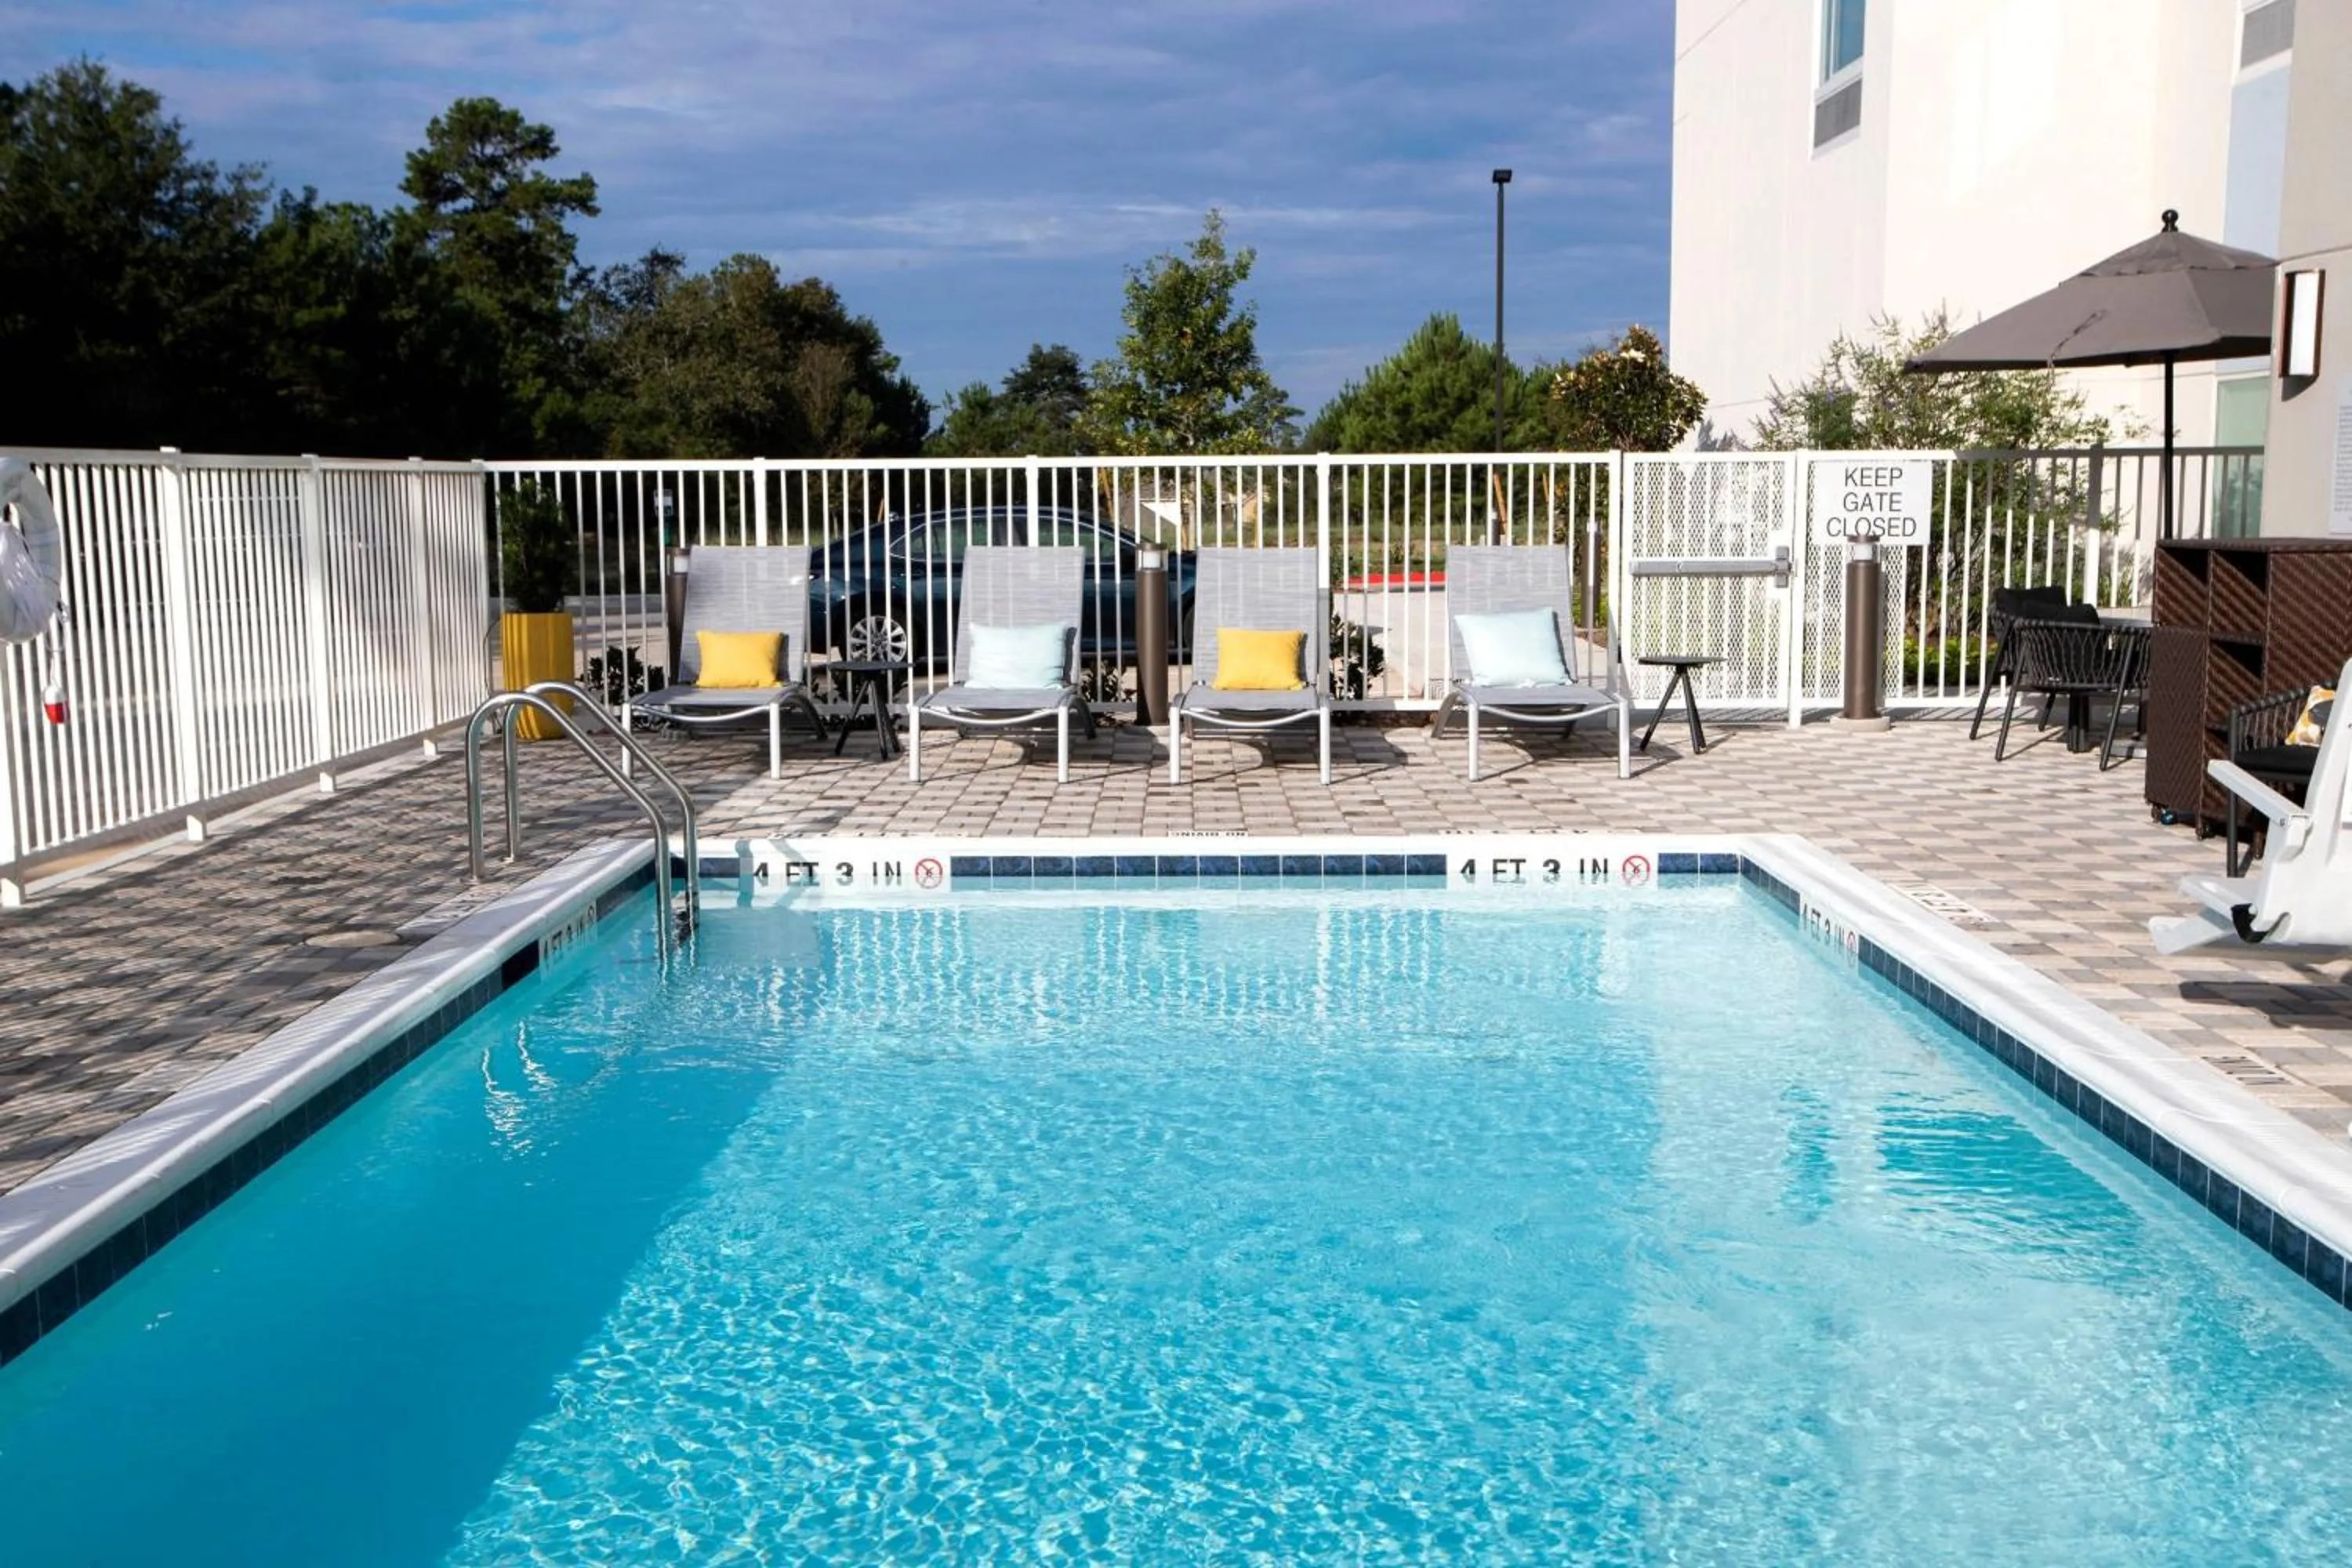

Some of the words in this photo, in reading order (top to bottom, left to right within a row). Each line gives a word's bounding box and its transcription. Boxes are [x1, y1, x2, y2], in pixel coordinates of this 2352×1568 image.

[1845, 467, 1903, 486] KEEP
[1843, 492, 1902, 512] GATE
[1826, 517, 1917, 537] CLOSED
[753, 862, 768, 878] 4
[786, 862, 819, 878] FT
[836, 862, 853, 879] 3
[873, 862, 901, 878] IN
[1461, 859, 1475, 875] 4
[1493, 859, 1526, 875] FT
[1543, 859, 1560, 875] 3
[1580, 858, 1608, 875] IN
